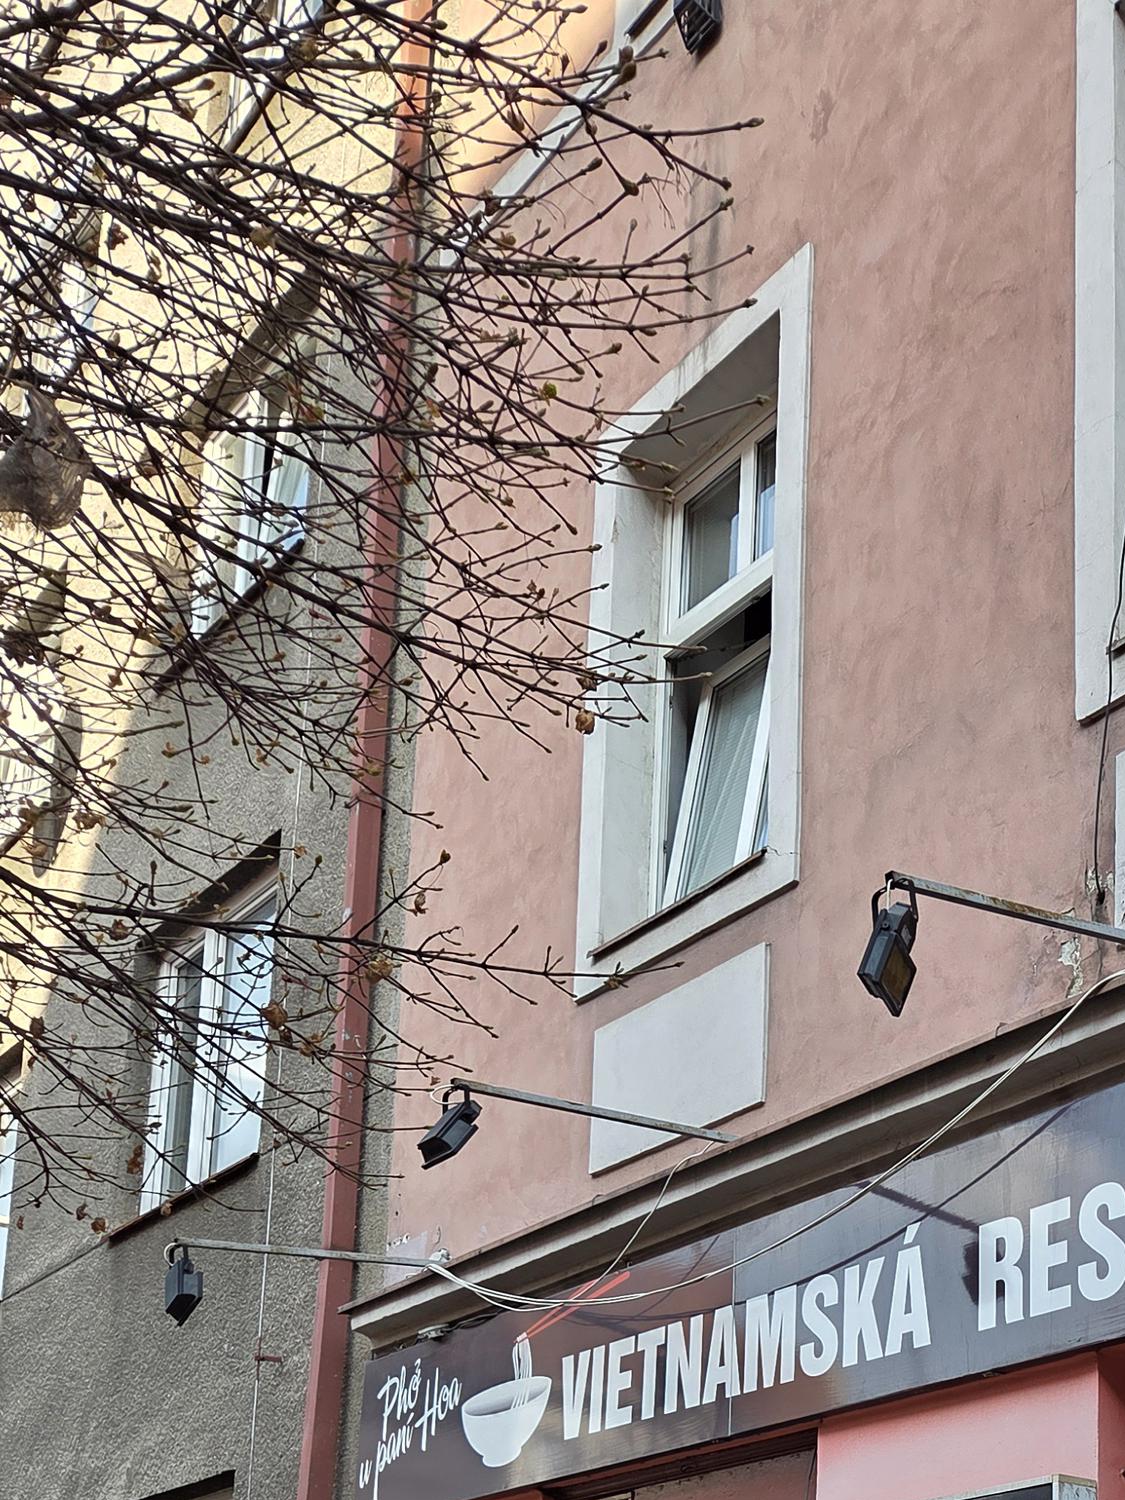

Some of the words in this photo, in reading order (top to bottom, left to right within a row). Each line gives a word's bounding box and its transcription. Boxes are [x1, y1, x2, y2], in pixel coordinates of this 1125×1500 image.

[561, 1223, 932, 1440] VIETNAMSKÁ
[359, 1459, 372, 1488] u
[415, 1367, 462, 1451] Hoa
